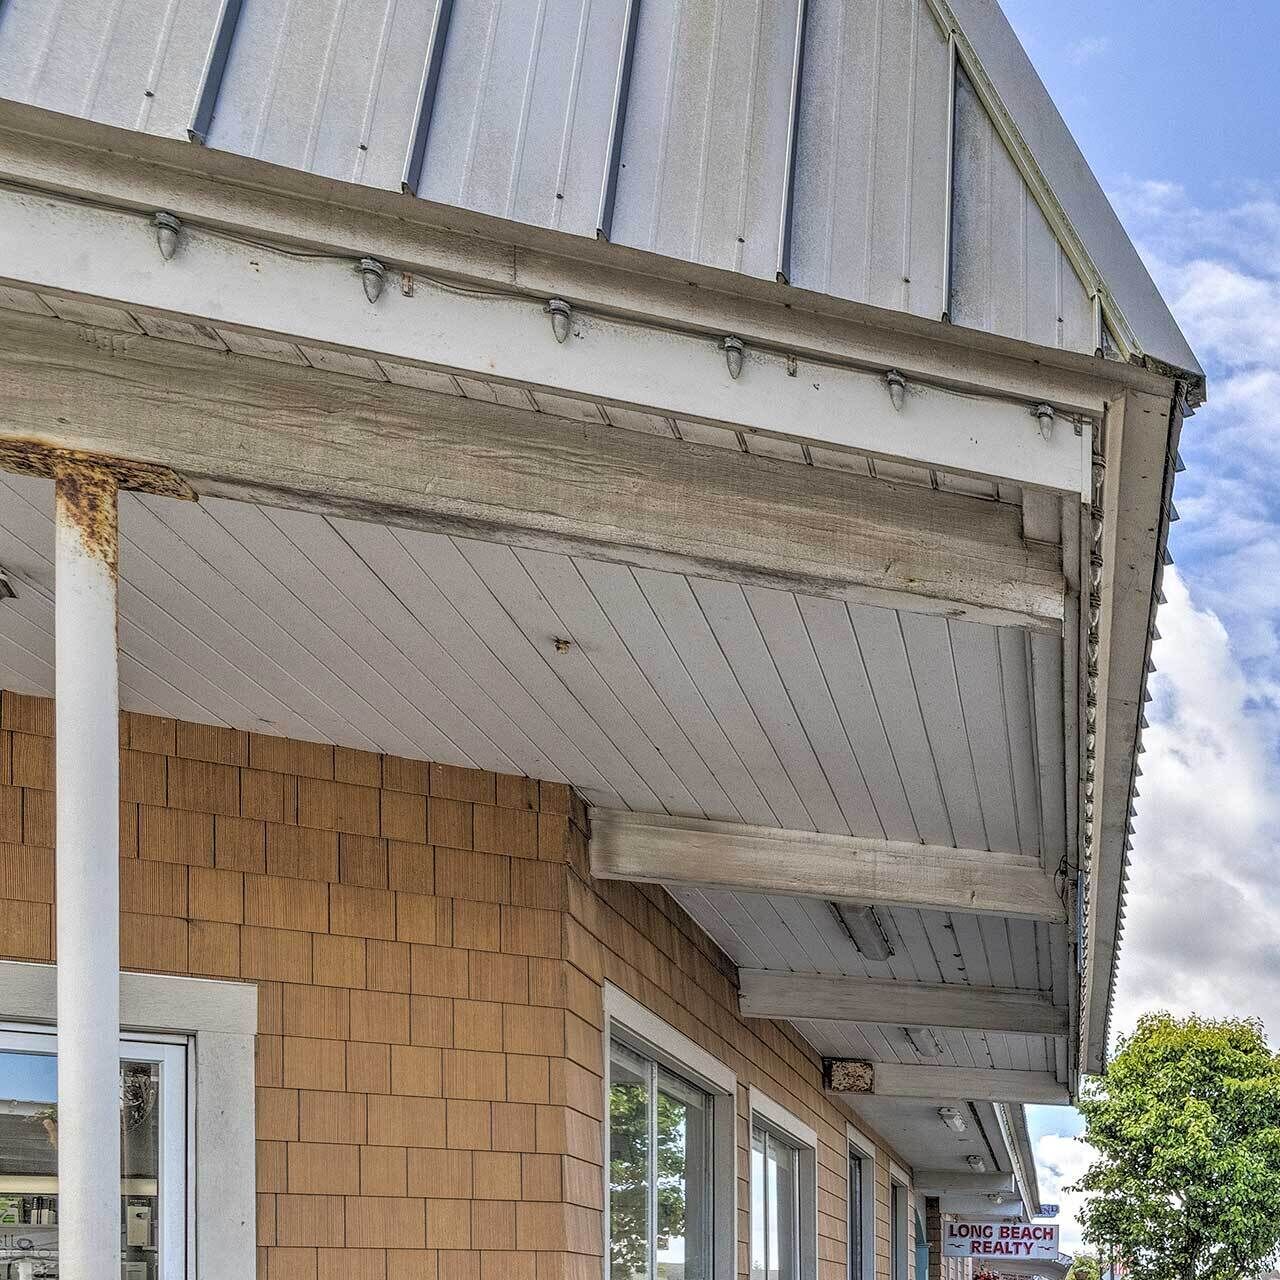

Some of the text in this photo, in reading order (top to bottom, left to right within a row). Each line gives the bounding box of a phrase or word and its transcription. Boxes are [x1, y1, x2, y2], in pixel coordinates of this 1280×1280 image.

[949, 1224, 1054, 1240] LONG BEACH
[970, 1240, 1035, 1255] REALTY
